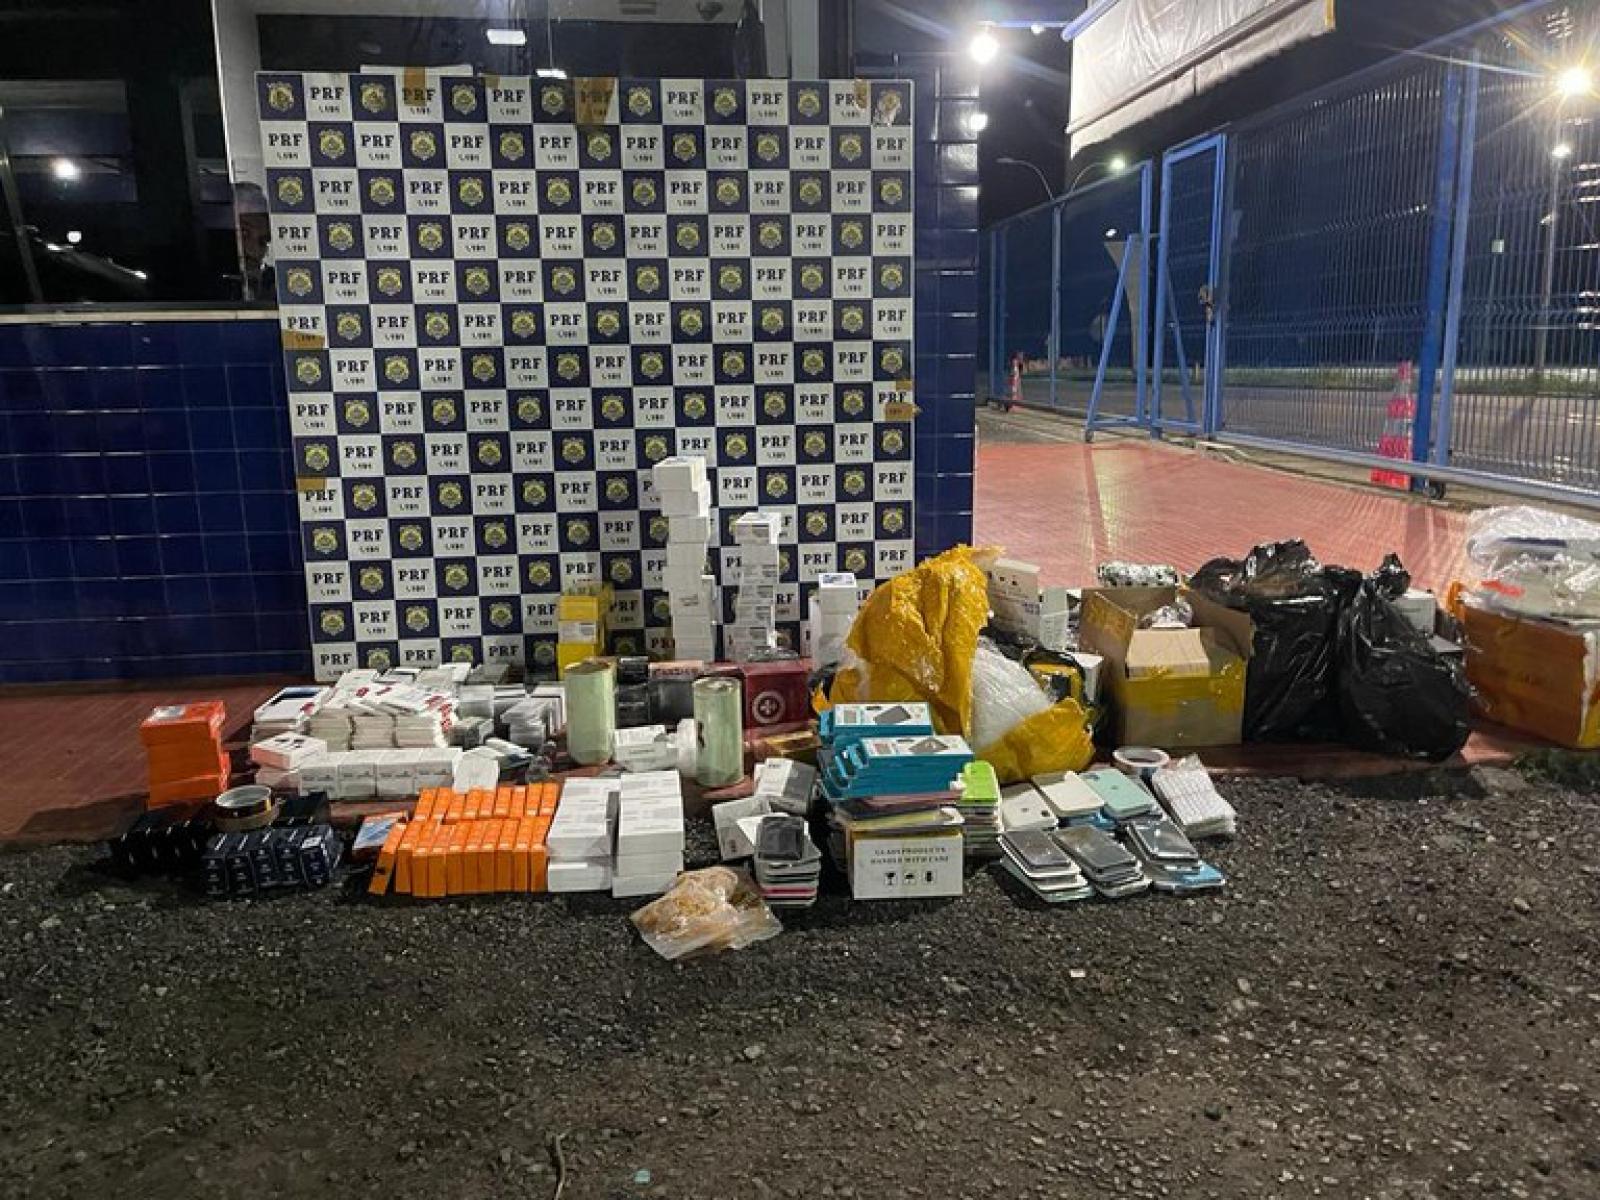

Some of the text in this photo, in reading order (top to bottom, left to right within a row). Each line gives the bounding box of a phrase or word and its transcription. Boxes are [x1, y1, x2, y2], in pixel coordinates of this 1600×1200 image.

[309, 86, 345, 101] PRF
[492, 88, 526, 103] PRF
[666, 91, 699, 105] PRF
[751, 91, 784, 105] PRF
[268, 132, 303, 147] PRF
[360, 134, 395, 149] PRF
[451, 134, 485, 149] PRF
[539, 135, 573, 149] PRF
[626, 136, 659, 151] PRF
[711, 136, 743, 151] PRF
[794, 136, 826, 151] PRF
[876, 137, 907, 151] PRF
[318, 180, 353, 194] PRF
[409, 180, 443, 195] PRF
[499, 180, 531, 195] PRF
[585, 180, 618, 195] PRF
[670, 180, 703, 195] PRF
[753, 180, 785, 195] PRF
[836, 180, 867, 195] PRF
[277, 226, 312, 240] PRF
[368, 226, 403, 241] PRF
[457, 226, 491, 240] PRF
[544, 226, 578, 239] PRF
[629, 226, 662, 239] PRF
[713, 224, 745, 239] PRF
[796, 224, 827, 238] PRF
[876, 224, 907, 238] PRF
[328, 270, 362, 285] PRF
[417, 270, 451, 284] PRF
[503, 270, 537, 284] PRF
[589, 269, 622, 283] PRF
[674, 268, 705, 282] PRF
[756, 268, 787, 282] PRF
[836, 267, 868, 281] PRF
[376, 315, 409, 329] PRF
[464, 314, 497, 328] PRF
[549, 313, 582, 326] PRF
[634, 312, 666, 326] PRF
[716, 311, 748, 324] PRF
[797, 310, 828, 324] PRF
[877, 309, 907, 322] PRF
[286, 316, 320, 330] PRF
[424, 357, 457, 372] PRF
[509, 357, 542, 370] PRF
[595, 355, 626, 369] PRF
[676, 353, 709, 368] PRF
[758, 353, 789, 366] PRF
[838, 351, 868, 365] PRF
[336, 359, 370, 374] PRF
[638, 397, 669, 410] PRF
[720, 395, 751, 409] PRF
[799, 393, 830, 407] PRF
[878, 391, 907, 405] PRF
[295, 403, 330, 418] PRF
[384, 401, 417, 416] PRF
[470, 399, 503, 414] PRF
[555, 399, 587, 412] PRF
[599, 439, 630, 453] PRF
[680, 437, 711, 451] PRF
[761, 435, 791, 449] PRF
[839, 432, 869, 447] PRF
[343, 445, 376, 459] PRF
[430, 443, 463, 457] PRF
[515, 441, 547, 455] PRF
[722, 476, 753, 490] PRF
[801, 474, 831, 487] PRF
[878, 471, 908, 484] PRF
[391, 486, 424, 499] PRF
[476, 483, 509, 497] PRF
[559, 481, 592, 495] PRF
[304, 489, 337, 503] PRF
[840, 512, 870, 525] PRF
[437, 526, 470, 539] PRF
[521, 524, 553, 537] PRF
[603, 520, 634, 534] PRF
[351, 528, 384, 543] PRF
[803, 552, 832, 566] PRF
[878, 549, 908, 562] PRF
[397, 568, 430, 582] PRF
[482, 565, 514, 578] PRF
[565, 561, 597, 575] PRF
[312, 572, 345, 585] PRF
[359, 610, 391, 624] PRF
[443, 607, 476, 620] PRF
[526, 603, 558, 617] PRF
[405, 649, 437, 662] PRF
[488, 645, 519, 658] PRF
[320, 652, 353, 666] PRF
